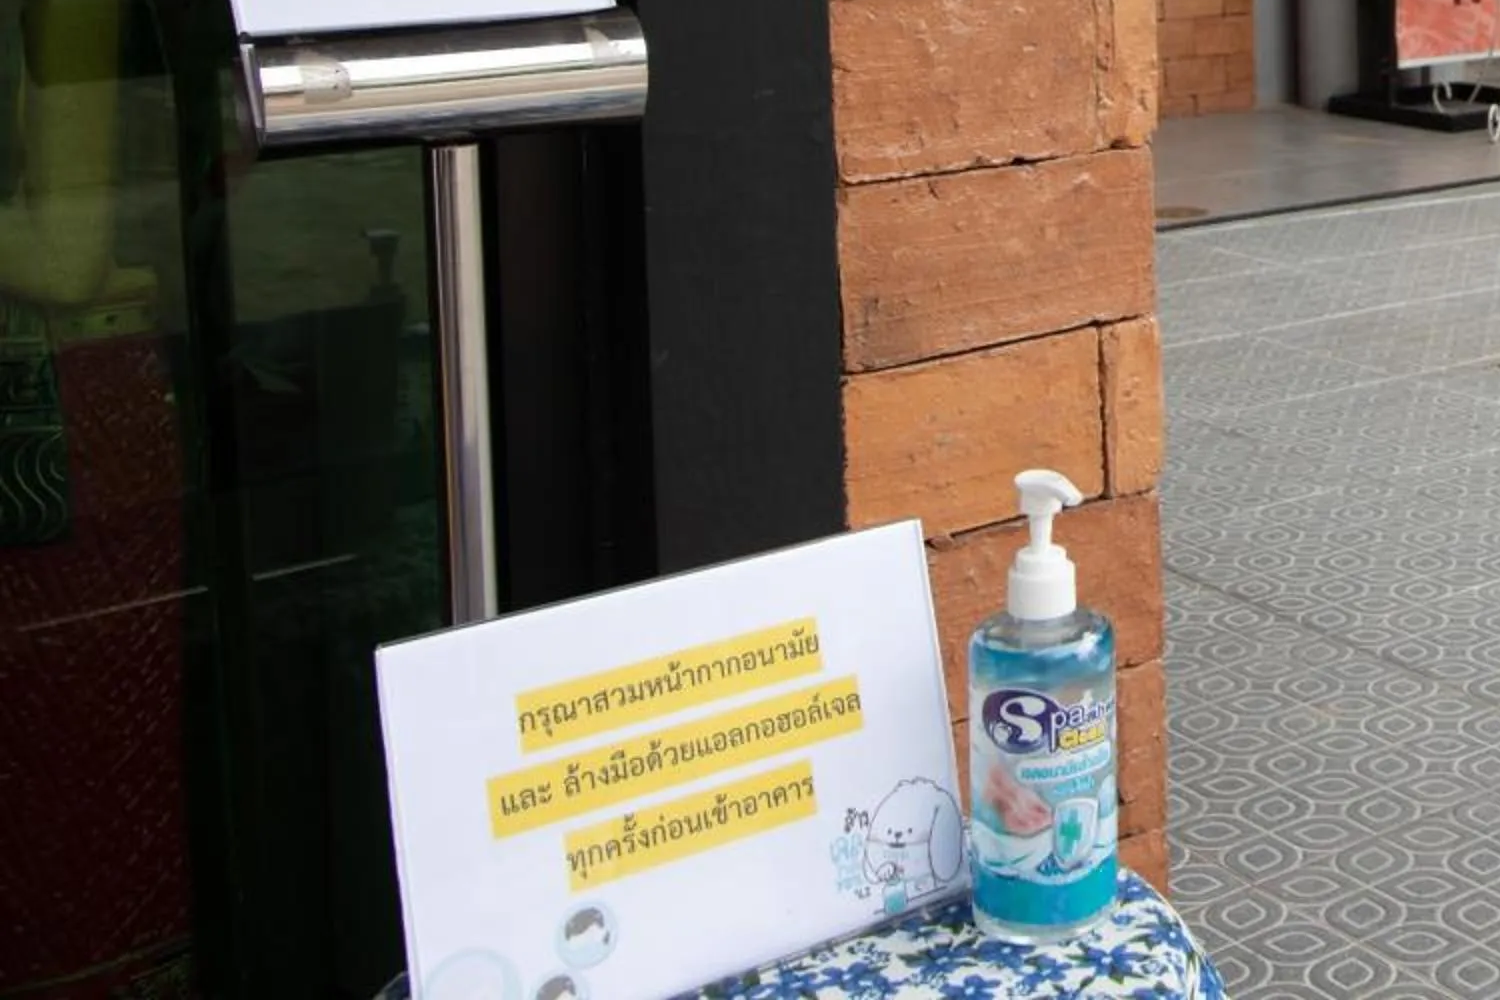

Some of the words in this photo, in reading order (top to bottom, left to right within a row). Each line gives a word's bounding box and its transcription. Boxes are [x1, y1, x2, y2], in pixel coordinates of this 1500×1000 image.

[517, 626, 821, 738] กรุณาสวมหน้ากากอนามัย
[499, 781, 553, 818] และ
[563, 686, 862, 800] ล้างมือด้วยแอลกอฮอล์เจล
[566, 772, 816, 880] ทุกครั้งก่อนเข้าอาคาร
